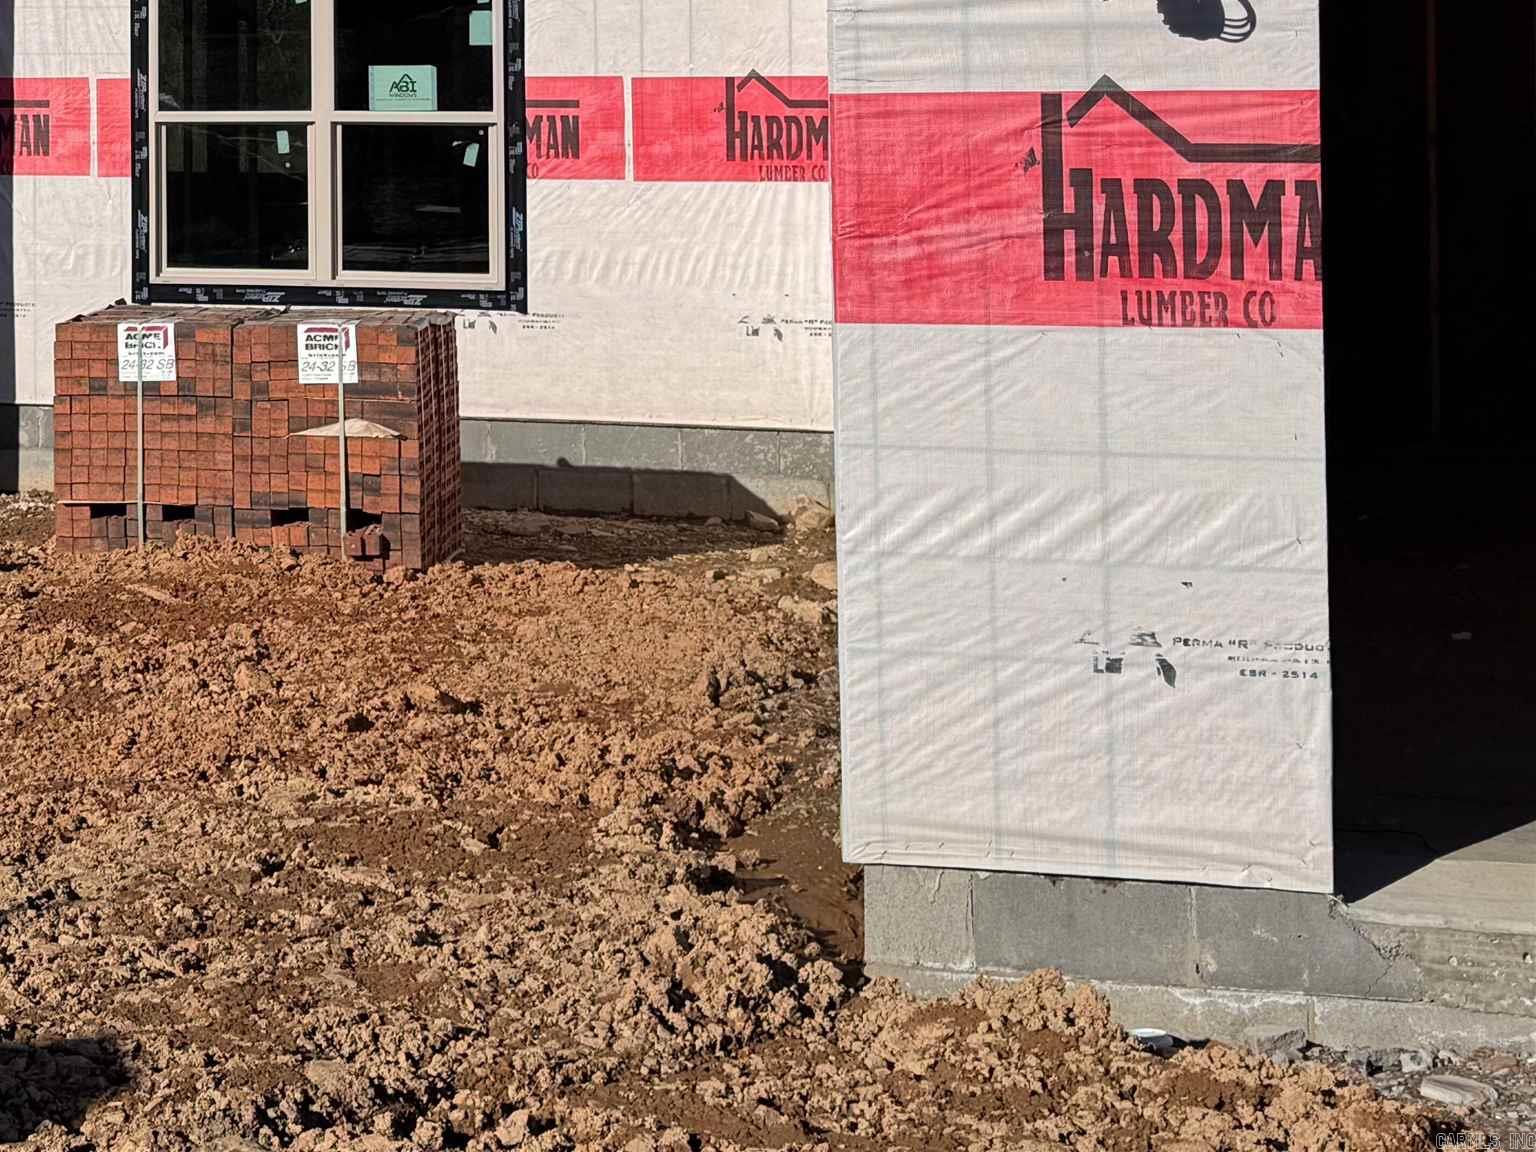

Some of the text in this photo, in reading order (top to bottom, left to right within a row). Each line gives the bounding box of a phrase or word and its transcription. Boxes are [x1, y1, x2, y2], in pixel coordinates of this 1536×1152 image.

[759, 164, 825, 182] LUMBER CO
[1120, 289, 1278, 329] LUMBER CO
[1172, 637, 1224, 649] PERMA
